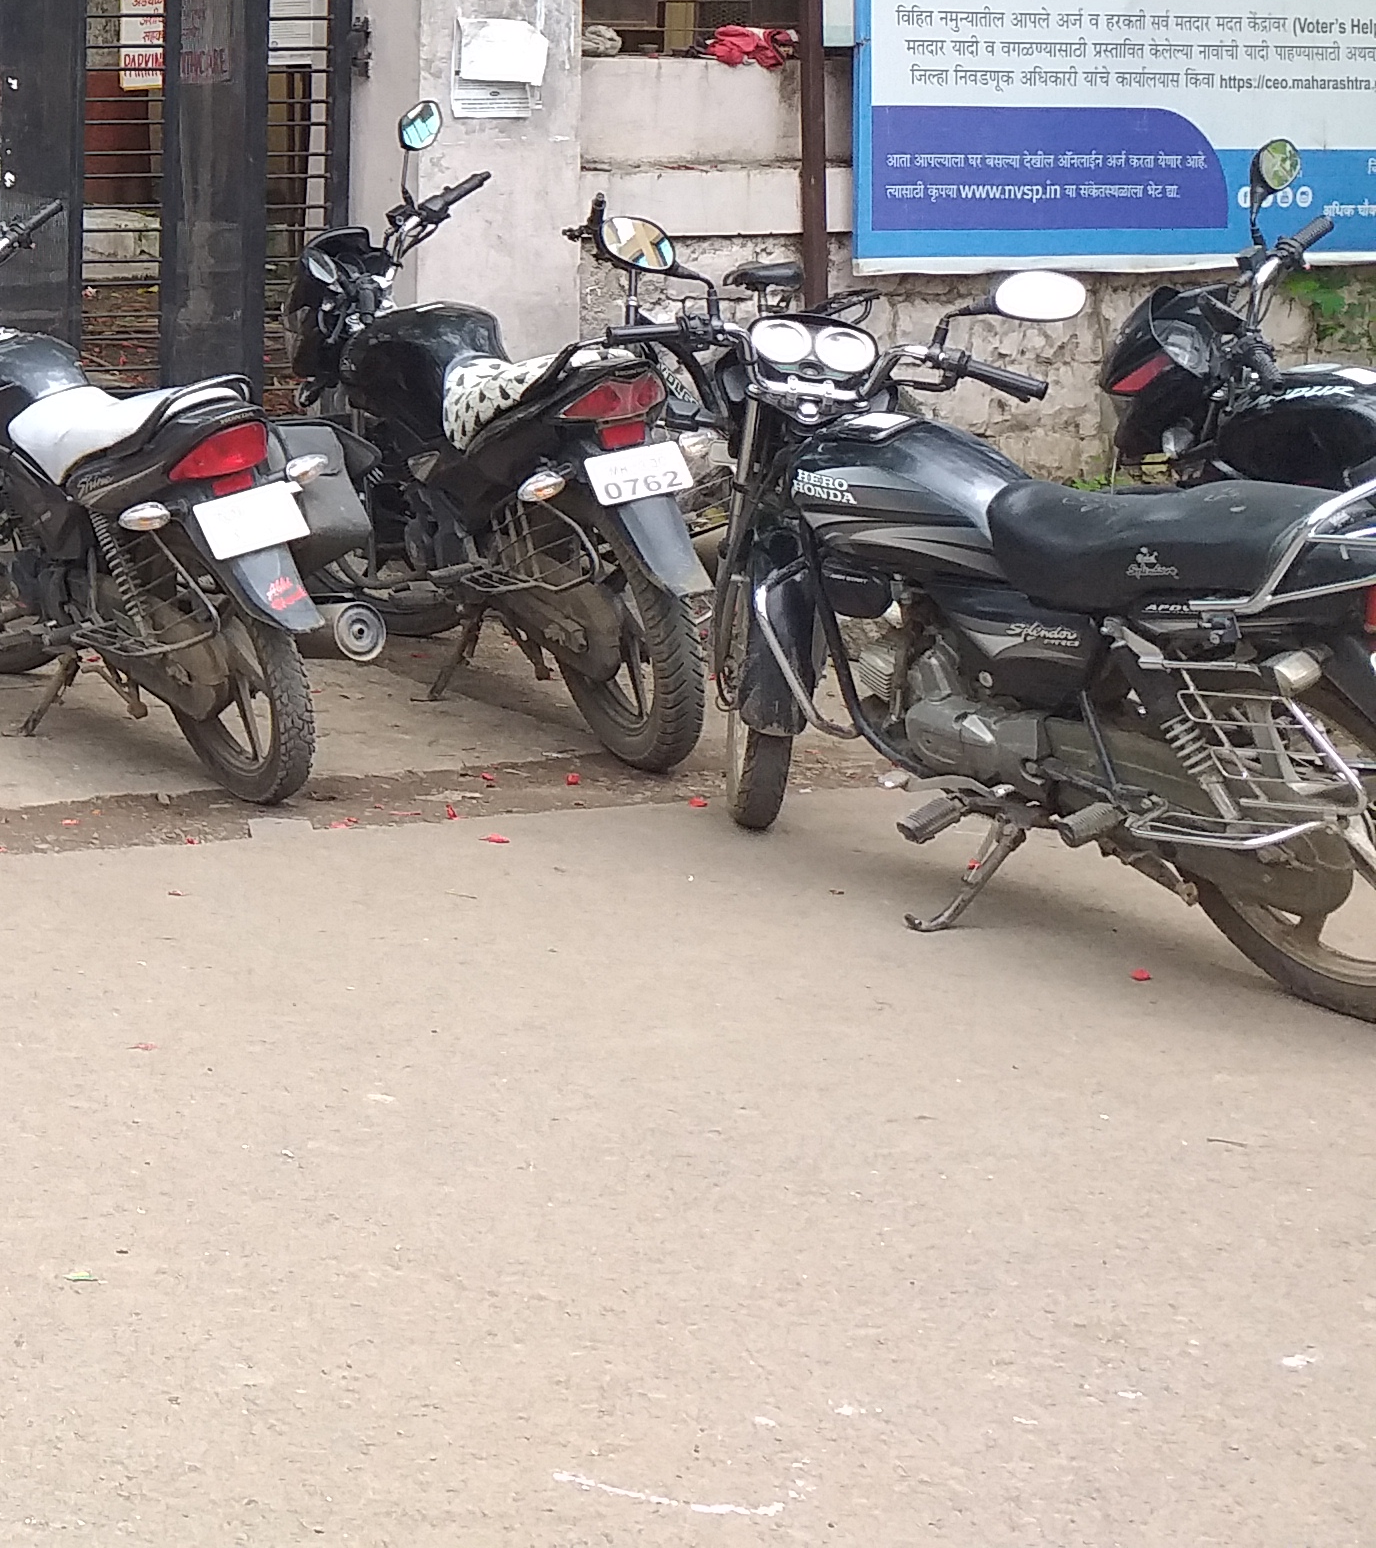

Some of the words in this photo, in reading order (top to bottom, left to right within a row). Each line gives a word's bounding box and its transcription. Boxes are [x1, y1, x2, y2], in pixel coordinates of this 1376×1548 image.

[895, 5, 934, 28] विहित
[938, 6, 1005, 32] नमुन्यातील
[1011, 7, 1050, 28] आपले
[1057, 8, 1083, 30] अर्ज
[1088, 13, 1099, 30] व
[1104, 10, 1146, 32] हरकती
[1150, 10, 1170, 31] सर्व
[1174, 15, 1211, 33] मतदार
[1216, 16, 1242, 32] मदत
[910, 64, 949, 87] जिल्हा
[954, 64, 1014, 92] निवडणूक
[1021, 66, 1078, 87] अधिकारी
[1082, 66, 1110, 88] यांचे
[1115, 66, 1180, 88] कार्यालयास
[887, 154, 911, 168] आता
[915, 154, 964, 168] आपल्याला
[1023, 150, 1054, 168] देखील
[1058, 151, 1103, 169] ऑनलाईन
[1107, 151, 1126, 168] अर्ज
[1129, 156, 1154, 168] करता
[1158, 155, 1182, 169] येणार
[886, 181, 924, 199] त्यासाठी
[928, 185, 957, 202] कृपया
[959, 180, 1060, 203] www.nvsp.in
[1064, 186, 1075, 199] या
[1147, 184, 1162, 198] भेट
[604, 470, 682, 500] 0762
[793, 479, 857, 504] HONDA
[797, 469, 848, 490] HERO
